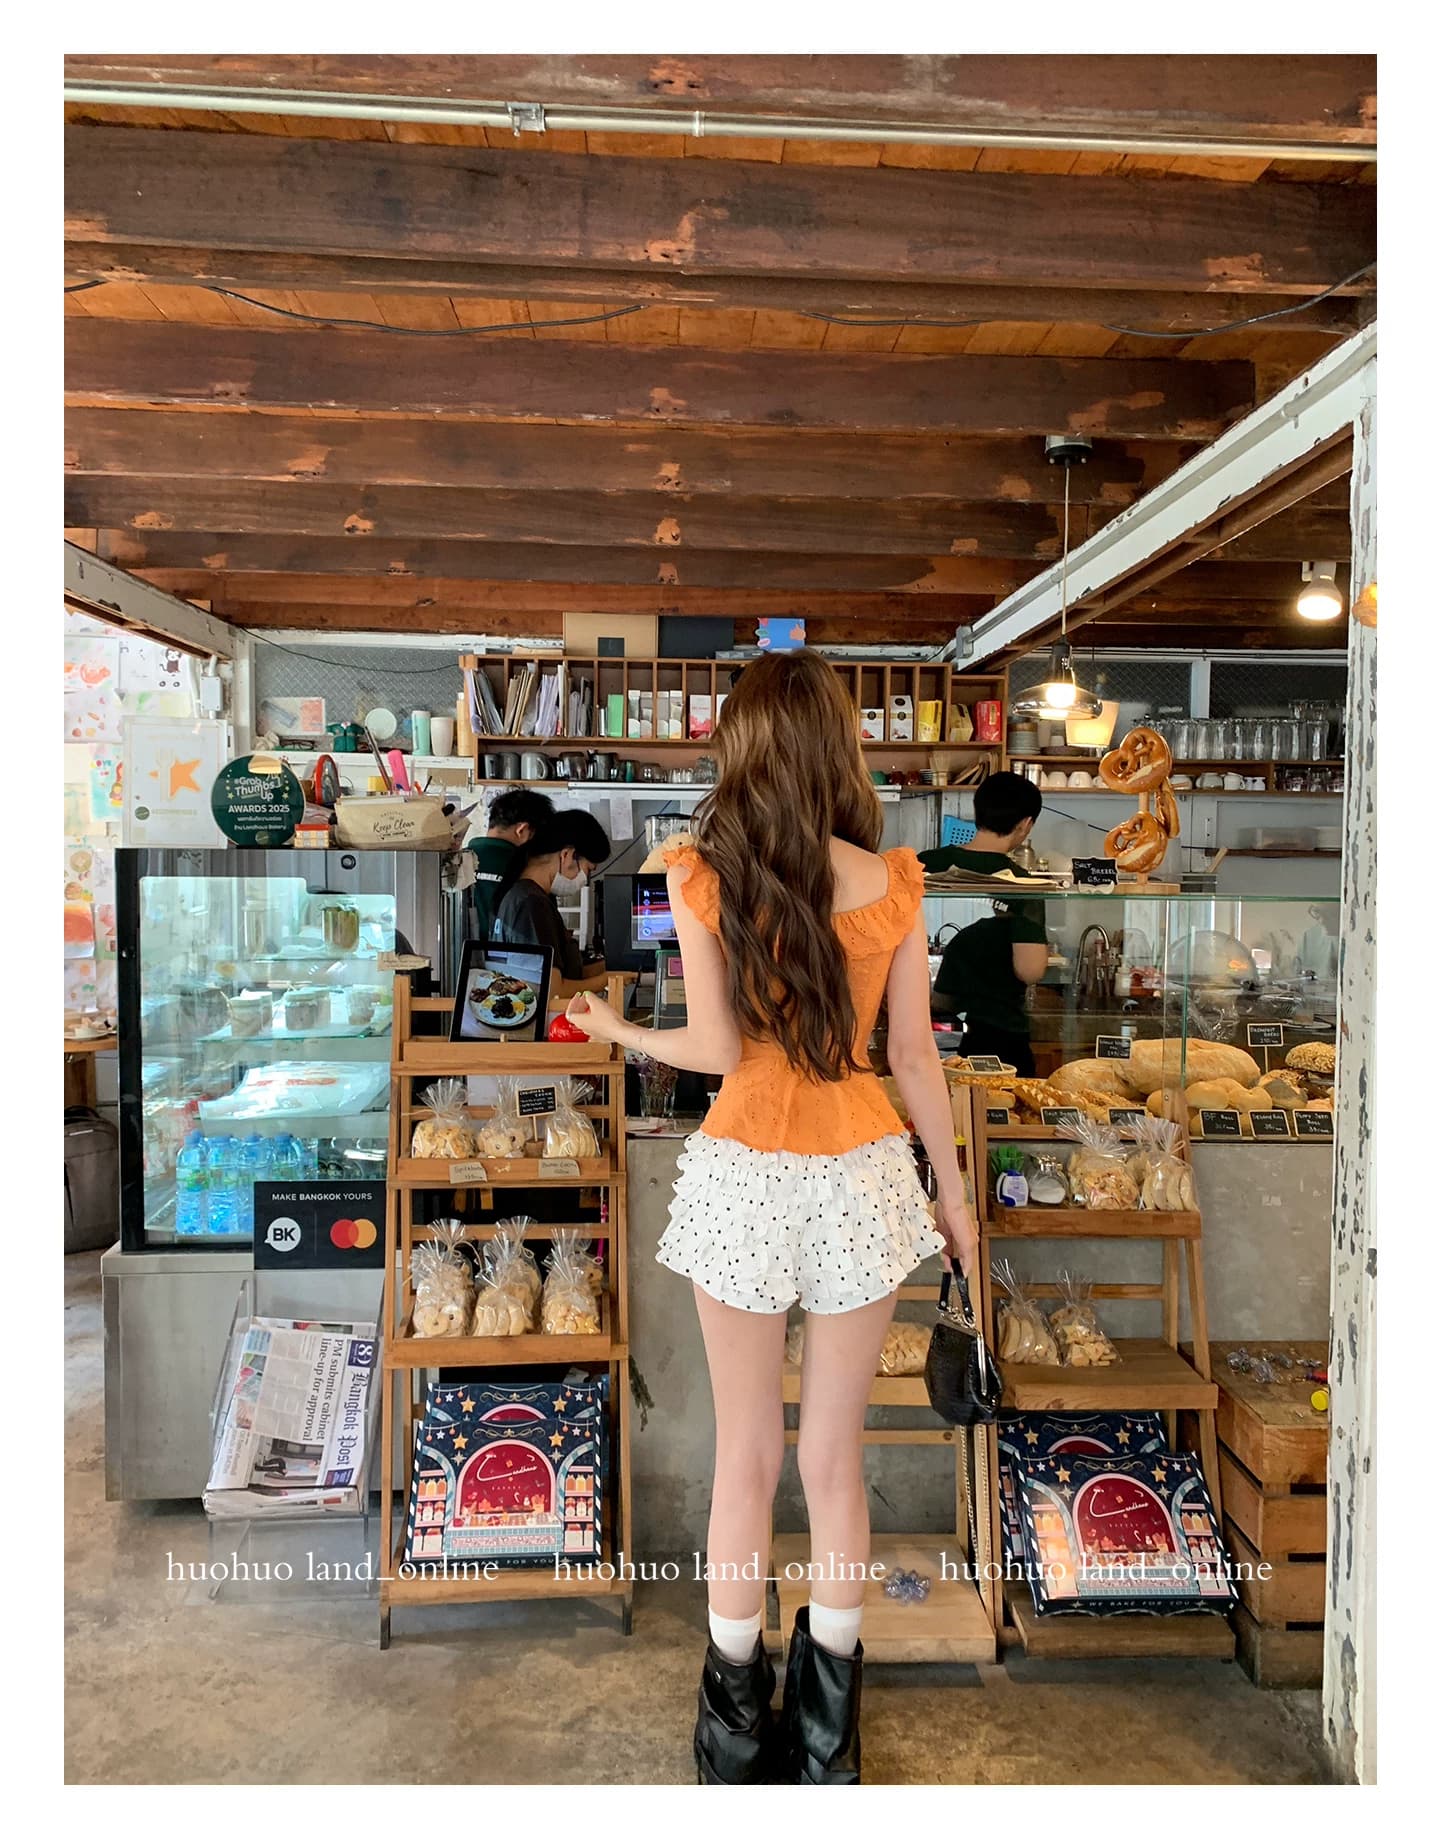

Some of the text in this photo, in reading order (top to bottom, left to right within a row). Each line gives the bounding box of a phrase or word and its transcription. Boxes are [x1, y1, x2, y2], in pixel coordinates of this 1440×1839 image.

[234, 781, 275, 796] Thumbs
[228, 804, 290, 813] AWARDS 2025
[272, 1193, 297, 1201] MAKE
[299, 1193, 342, 1201] BANGKOK
[272, 1227, 296, 1242] BK
[302, 1338, 332, 1441] line-up for approval
[316, 1338, 344, 1440] PM submits cabinet
[343, 1372, 369, 1430] Bangkok
[336, 1435, 358, 1466] Post
